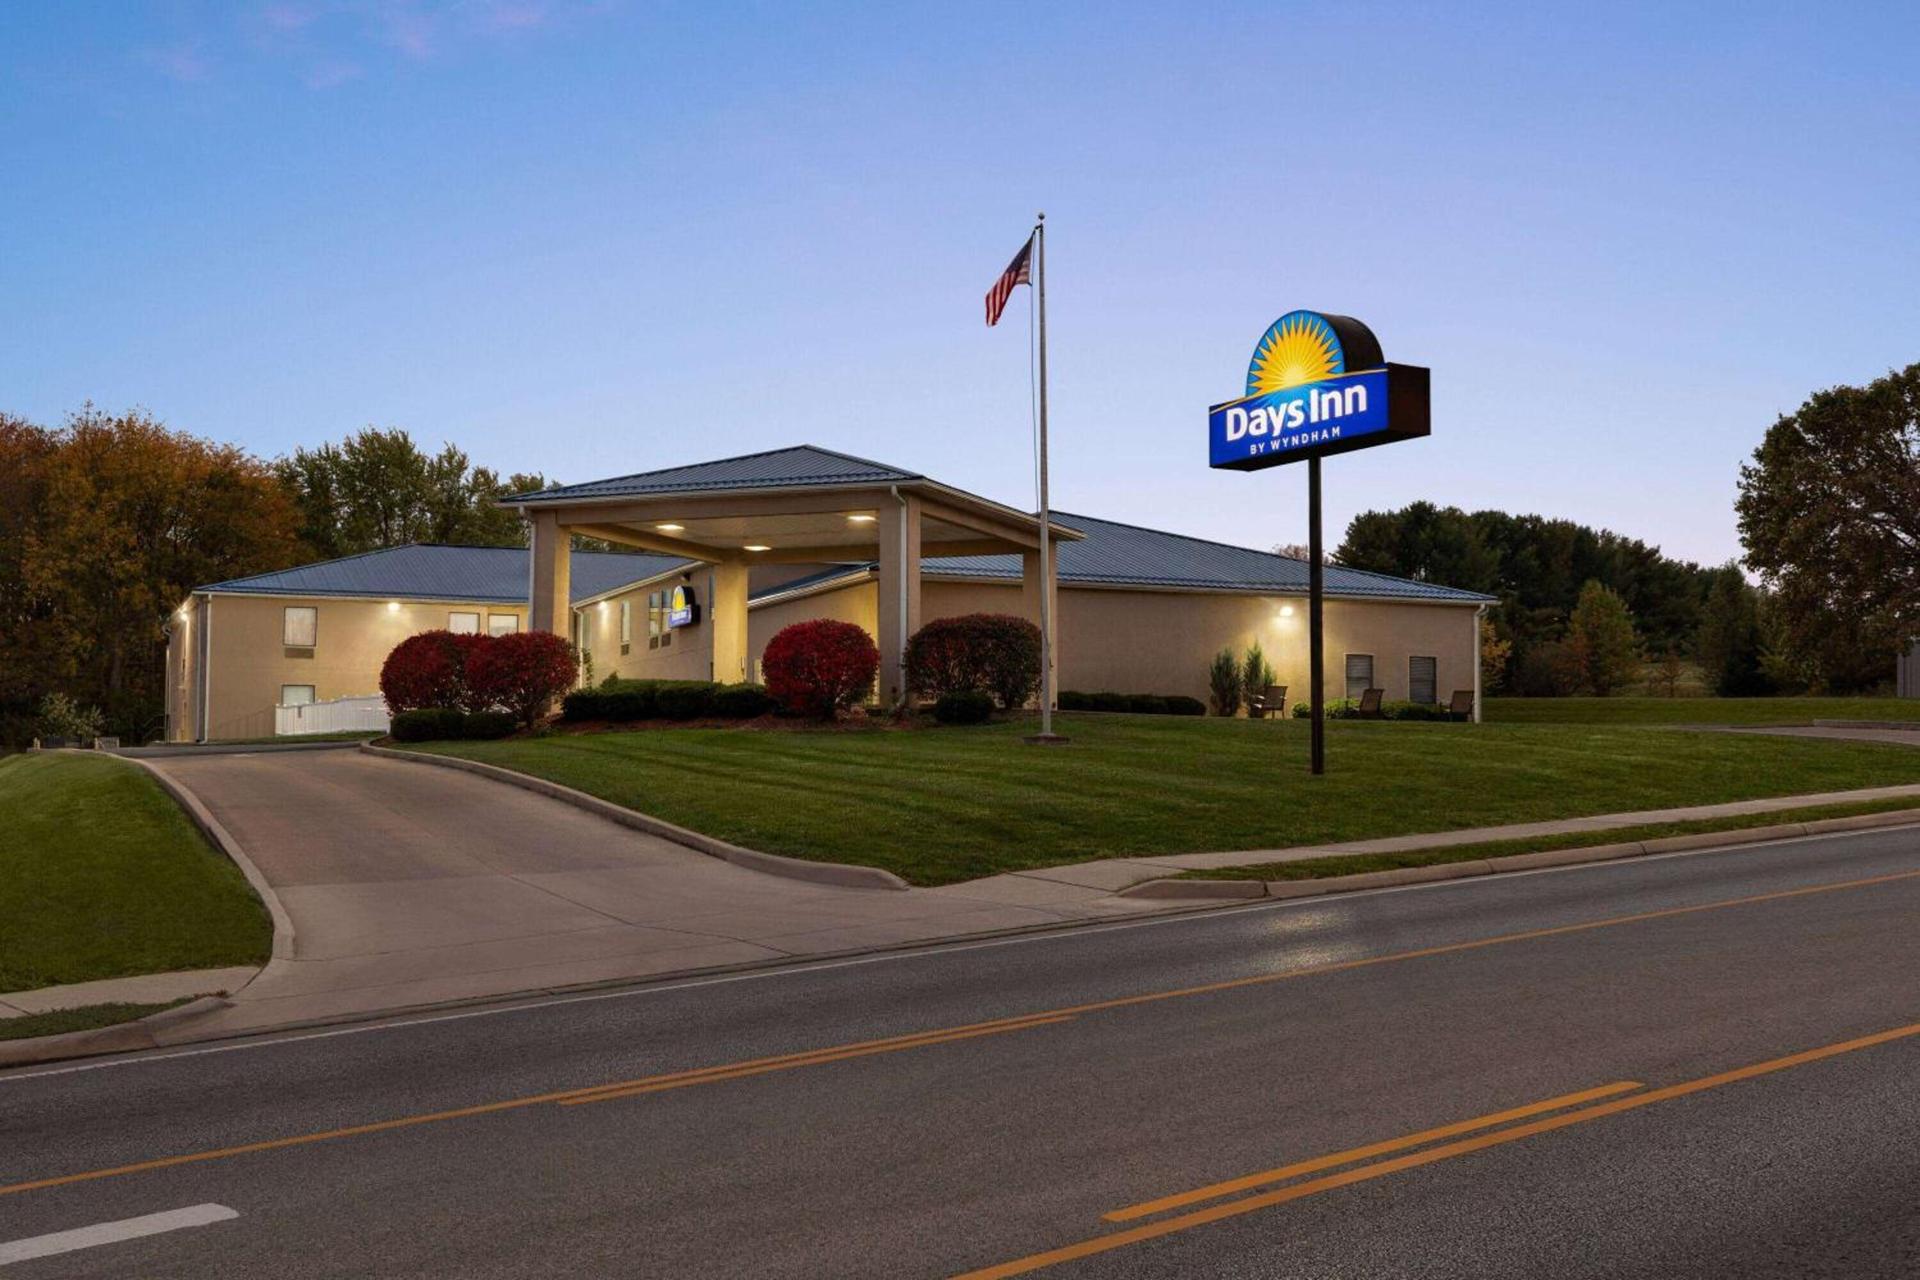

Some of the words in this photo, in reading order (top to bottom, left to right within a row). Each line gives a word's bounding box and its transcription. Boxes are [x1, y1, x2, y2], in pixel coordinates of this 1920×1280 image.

[1226, 398, 1304, 442] Days
[1310, 384, 1367, 423] Inn
[1250, 442, 1265, 455] BY
[1270, 426, 1341, 450] WYNDHAM
